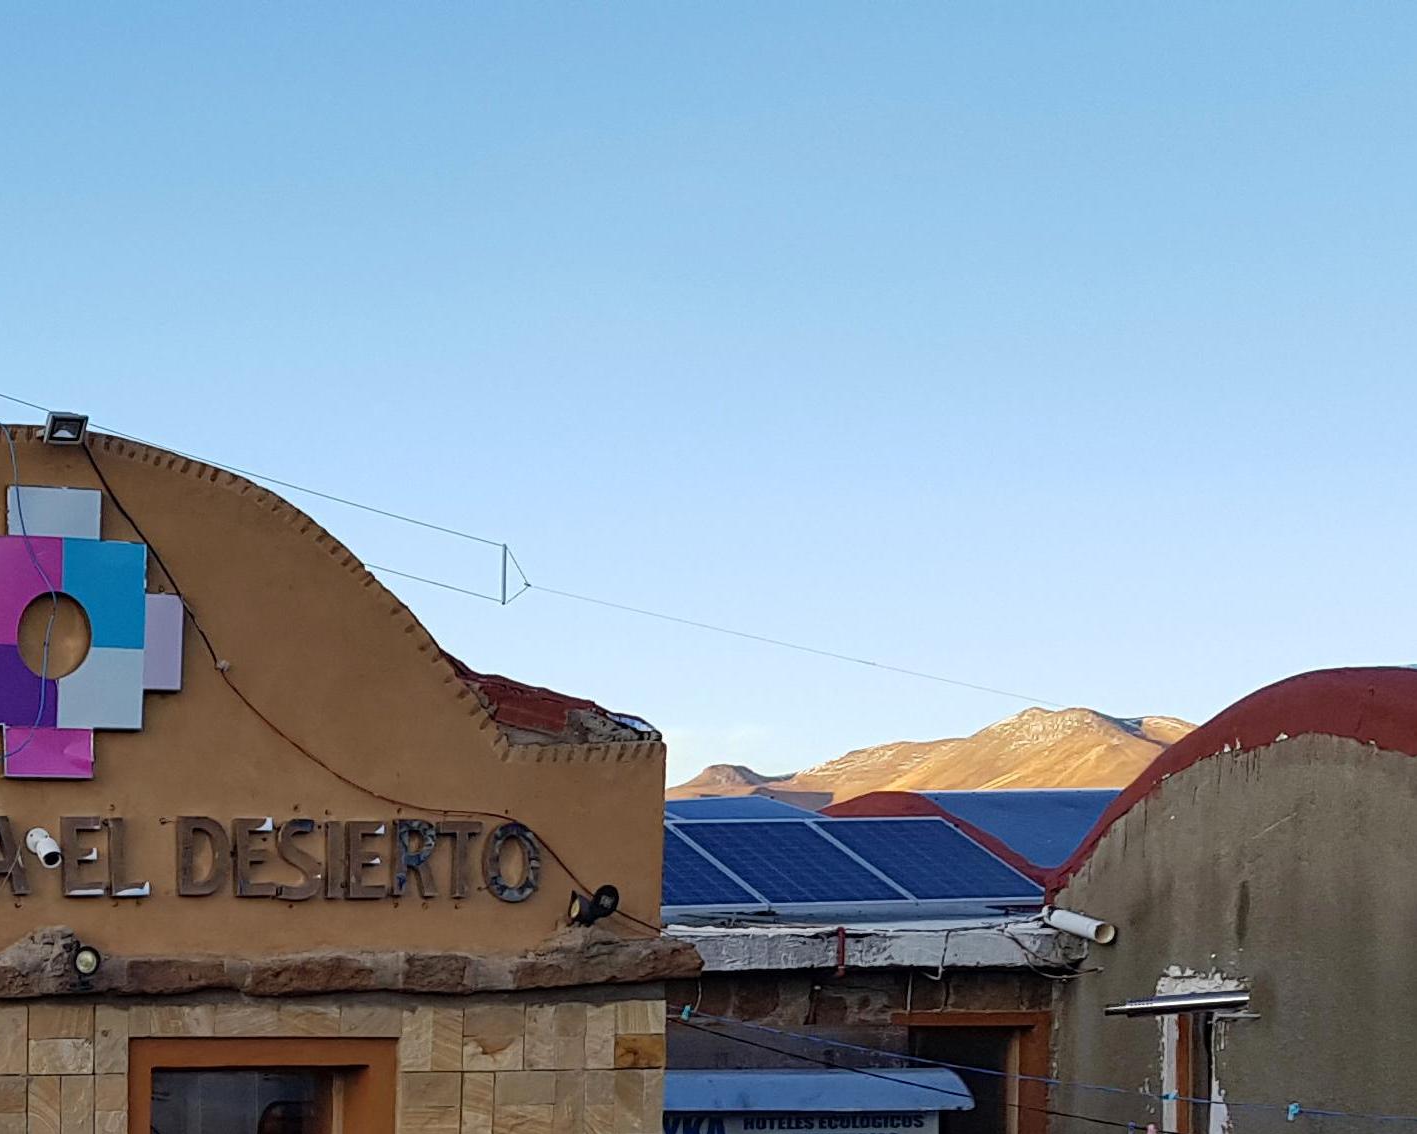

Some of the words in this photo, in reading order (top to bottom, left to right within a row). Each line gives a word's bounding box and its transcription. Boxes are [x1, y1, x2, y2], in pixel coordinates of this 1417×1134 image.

[59, 815, 150, 898] EL
[176, 815, 542, 902] DESIERTO
[743, 1116, 815, 1131] HOTELES
